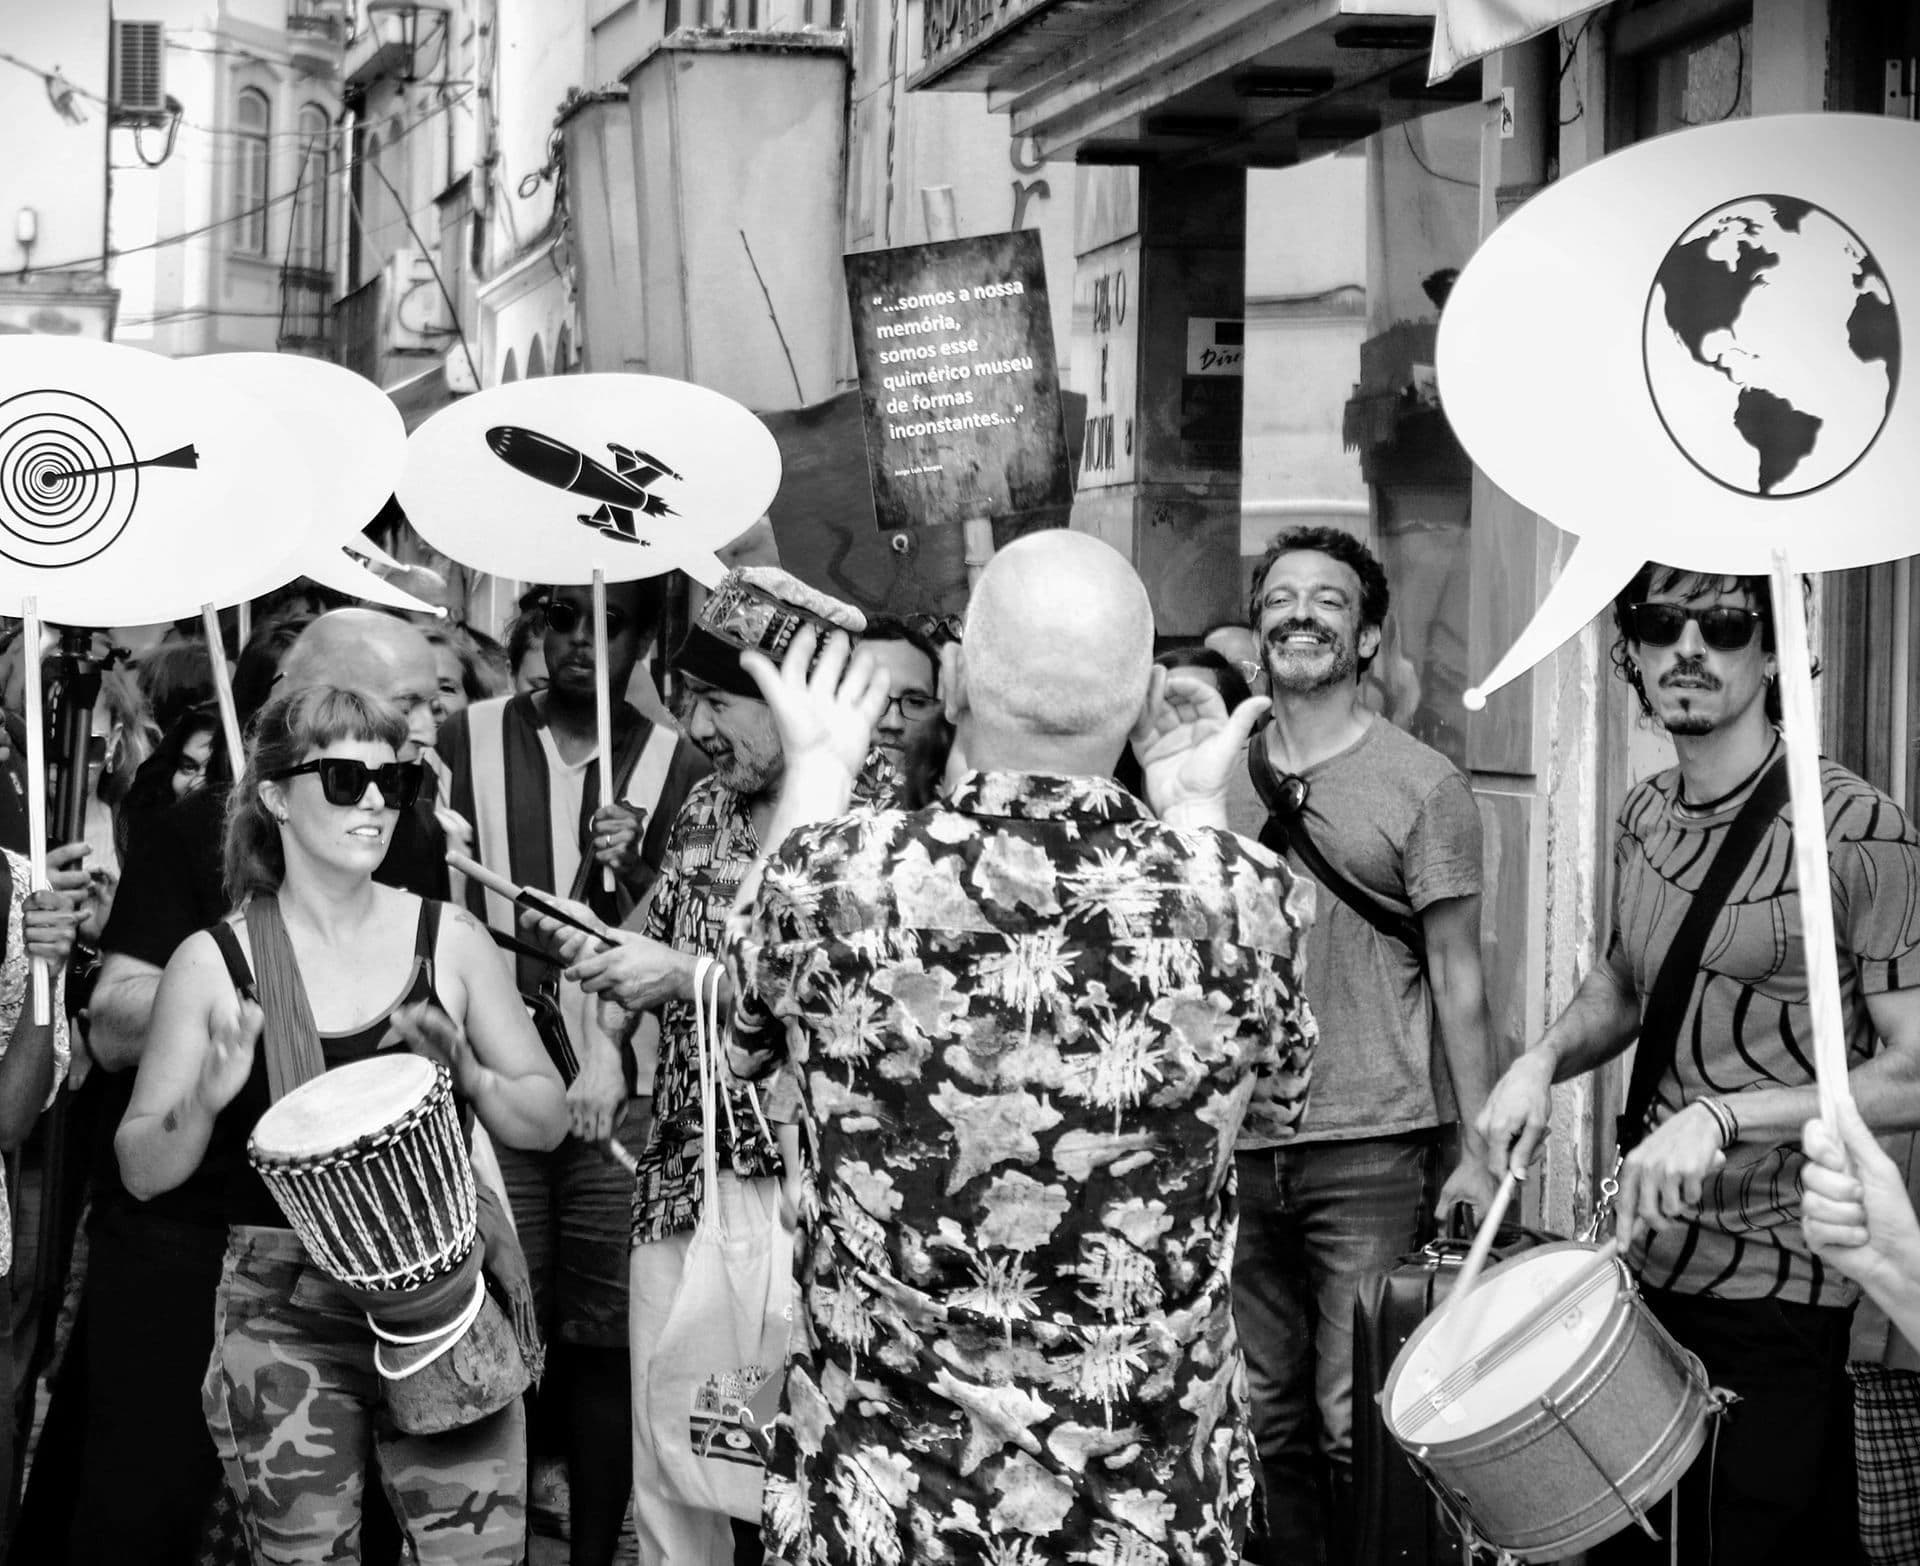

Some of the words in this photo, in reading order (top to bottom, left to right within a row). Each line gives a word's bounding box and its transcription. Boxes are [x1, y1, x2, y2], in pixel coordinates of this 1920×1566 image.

[959, 288, 970, 302] a
[974, 280, 1024, 299] nossa
[877, 315, 961, 339] memória,
[880, 343, 936, 364] somos
[940, 337, 979, 356] esse
[883, 363, 971, 392] quimérico
[975, 355, 1033, 376] museu
[886, 395, 909, 414] de
[912, 390, 974, 411] formas
[889, 404, 1024, 440] inconstantes...”
